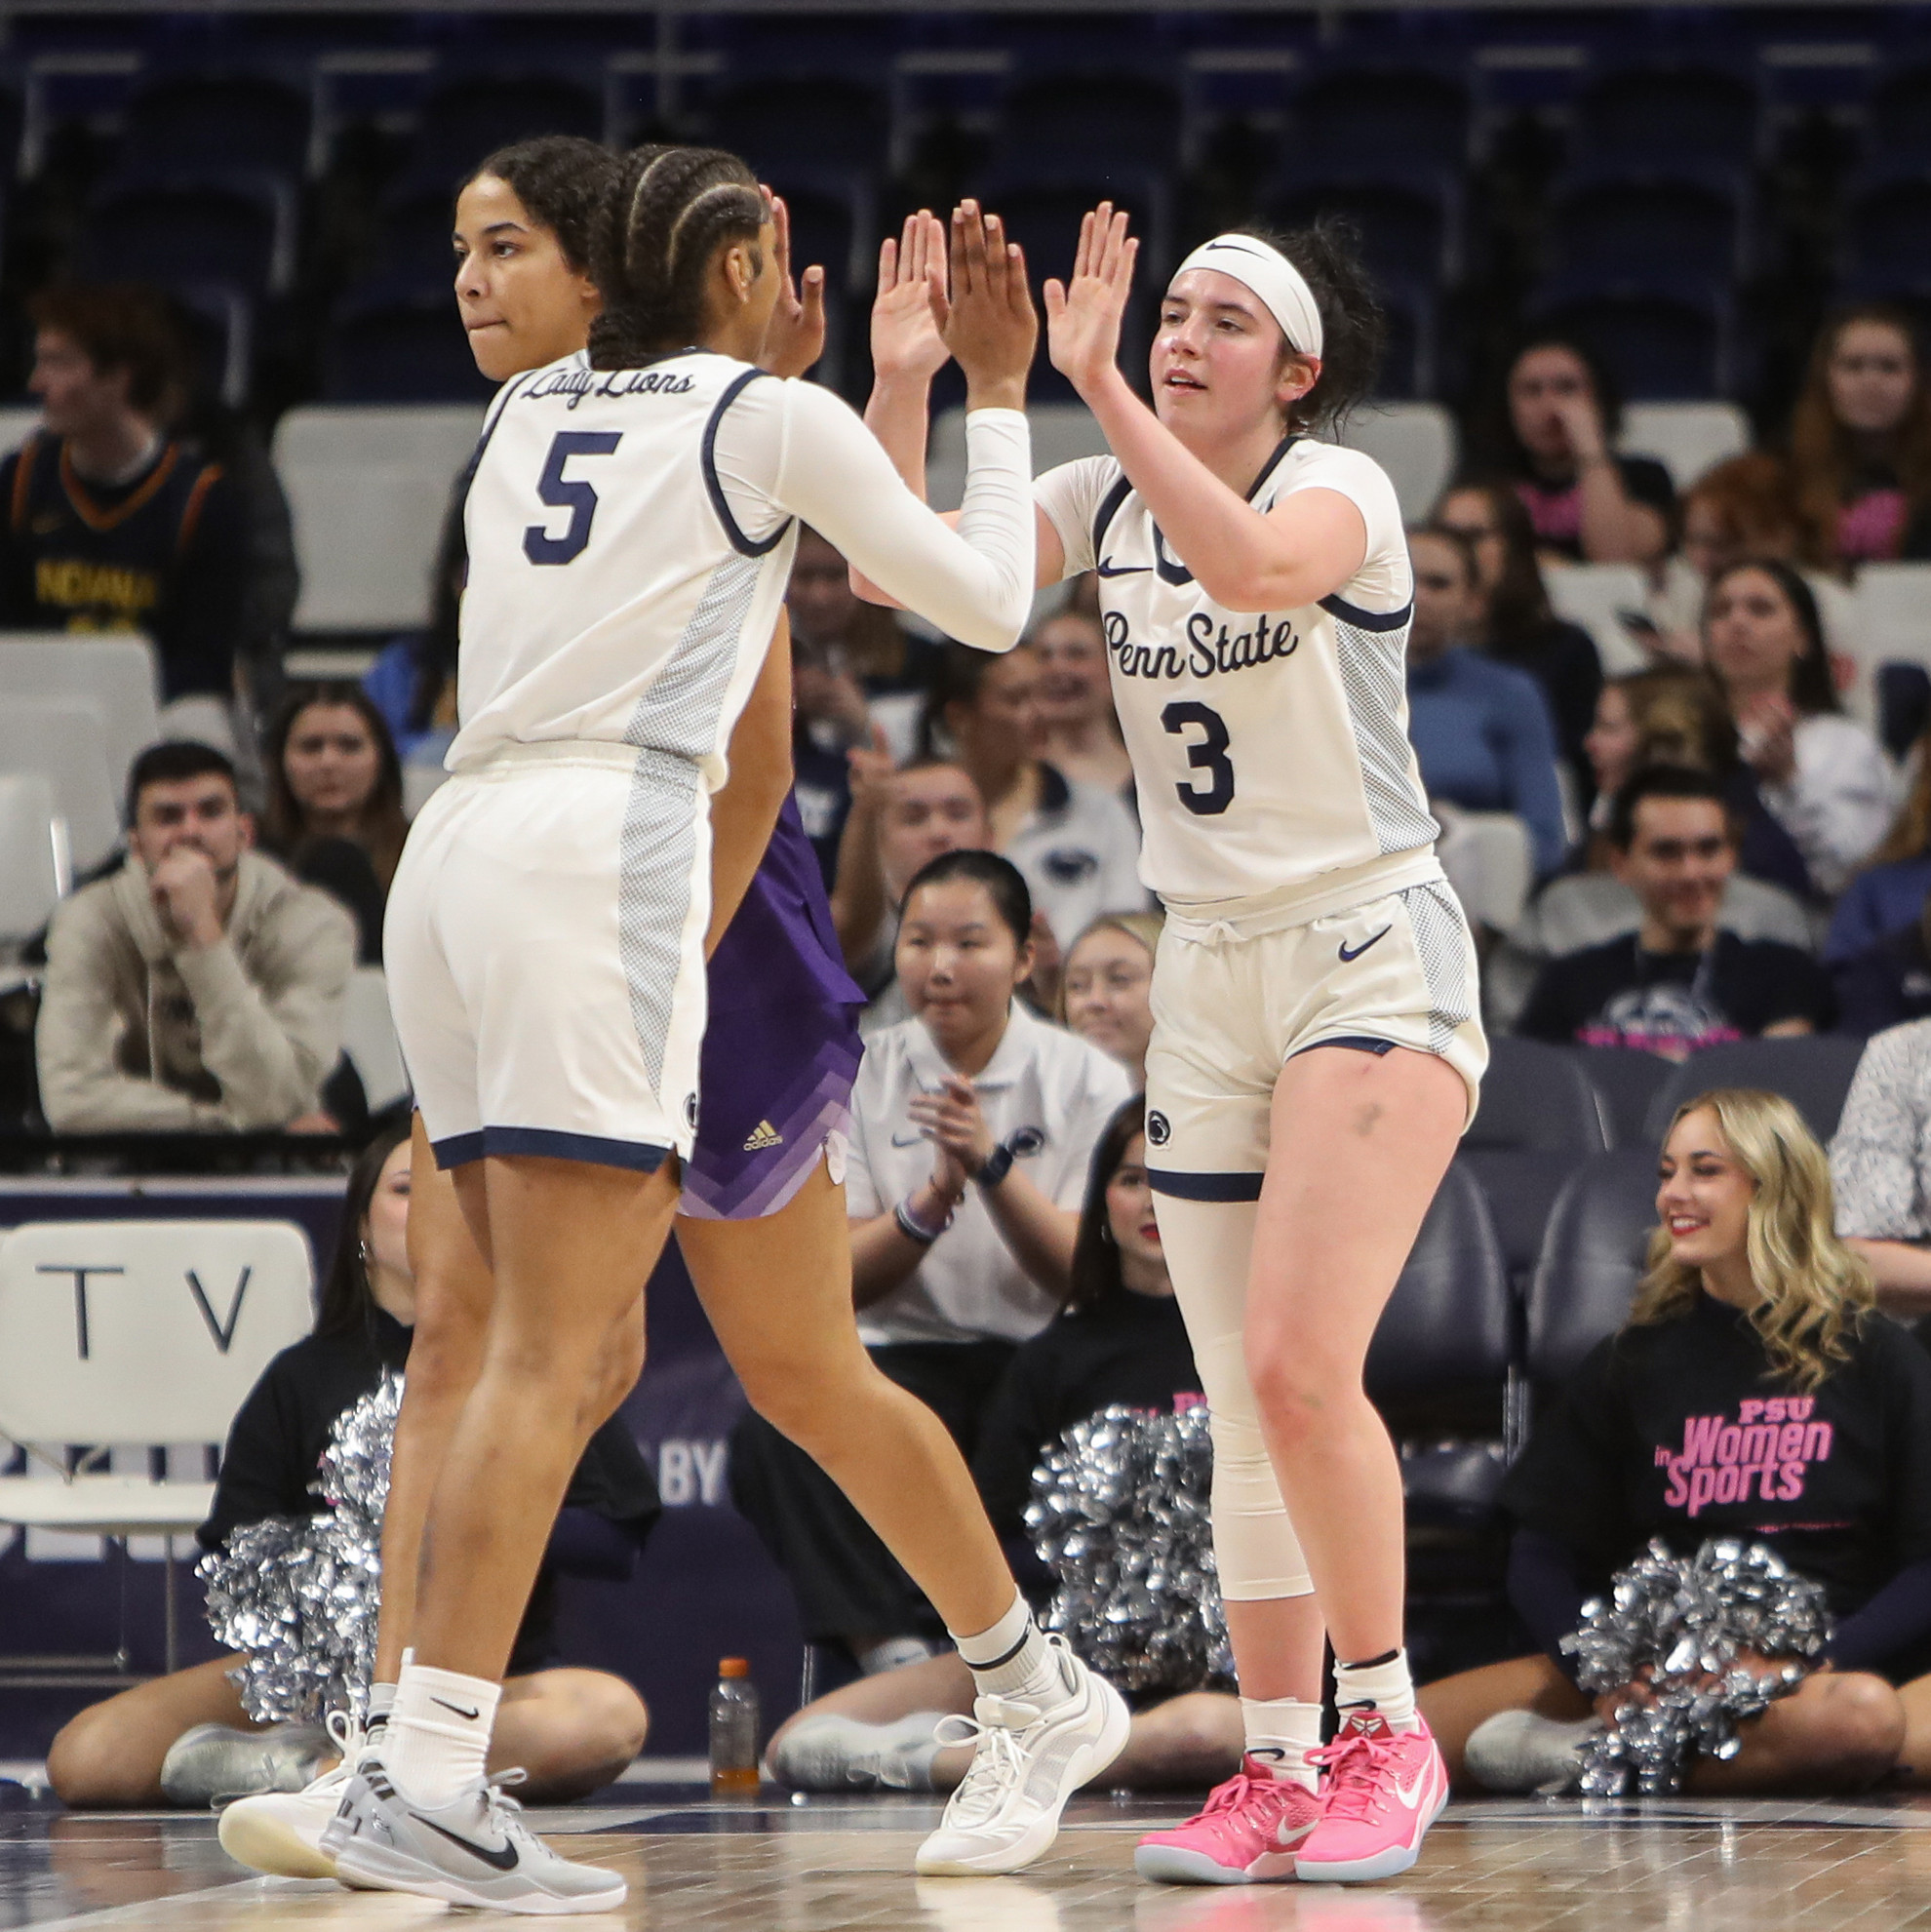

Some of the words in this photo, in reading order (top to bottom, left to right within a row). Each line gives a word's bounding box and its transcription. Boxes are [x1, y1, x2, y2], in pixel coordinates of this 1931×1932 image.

[520, 368, 594, 411] Lady
[594, 370, 696, 398] Lions
[522, 431, 623, 566] 5
[1103, 611, 1186, 679] Penn
[1186, 612, 1299, 680] State
[1160, 701, 1236, 816] 3
[742, 1135, 783, 1152] adidas
[1682, 1416, 1833, 1468] Women
[1738, 1397, 1815, 1425] PSU
[658, 1439, 727, 1506] BY
[1654, 1445, 1672, 1467] in
[1664, 1455, 1807, 1518] Sports
